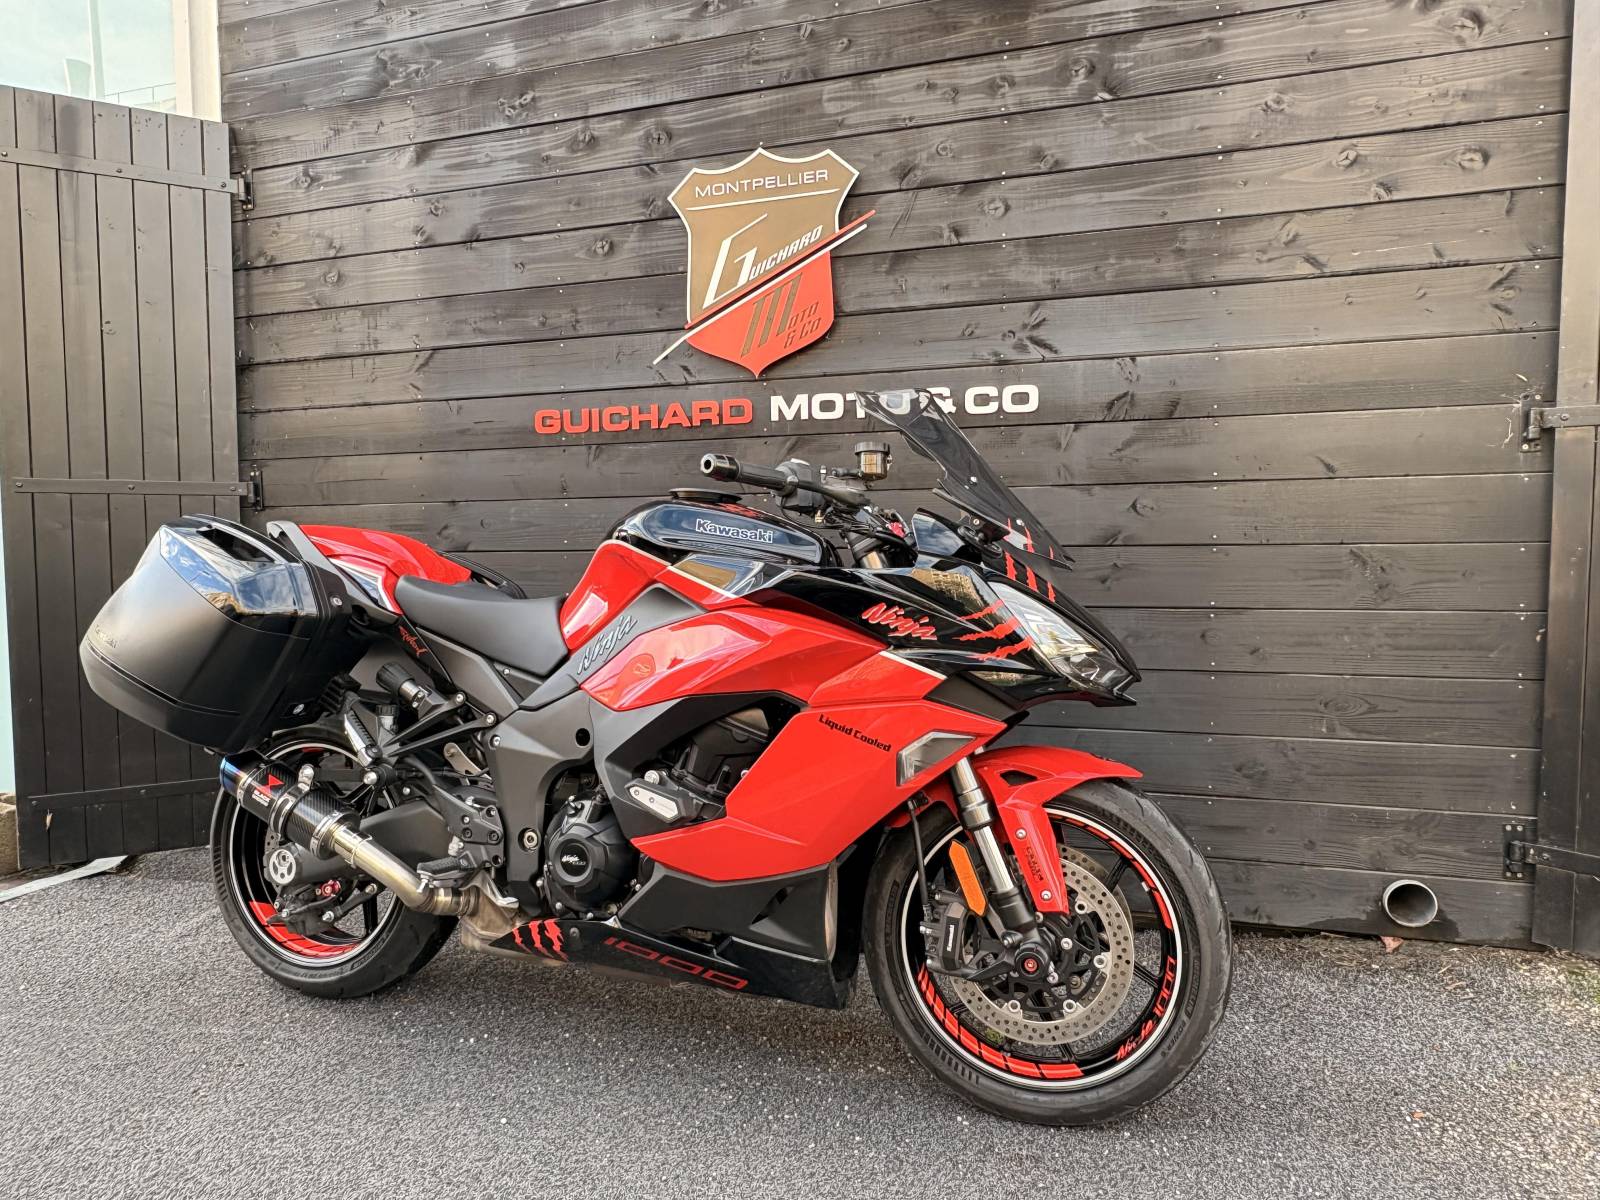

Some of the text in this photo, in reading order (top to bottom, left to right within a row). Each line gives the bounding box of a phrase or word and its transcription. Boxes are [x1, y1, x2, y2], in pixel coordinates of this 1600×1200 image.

[695, 169, 829, 199] MONTPELLIER
[702, 212, 824, 310] GUICHARD
[533, 398, 754, 435] GUICHARD
[695, 518, 774, 544] Kawasaki
[861, 602, 938, 641] Ninja
[576, 614, 639, 676] Ninja
[818, 713, 892, 752] Liquid Cooled
[603, 936, 749, 990] 1000
[1152, 954, 1177, 1018] 1000
